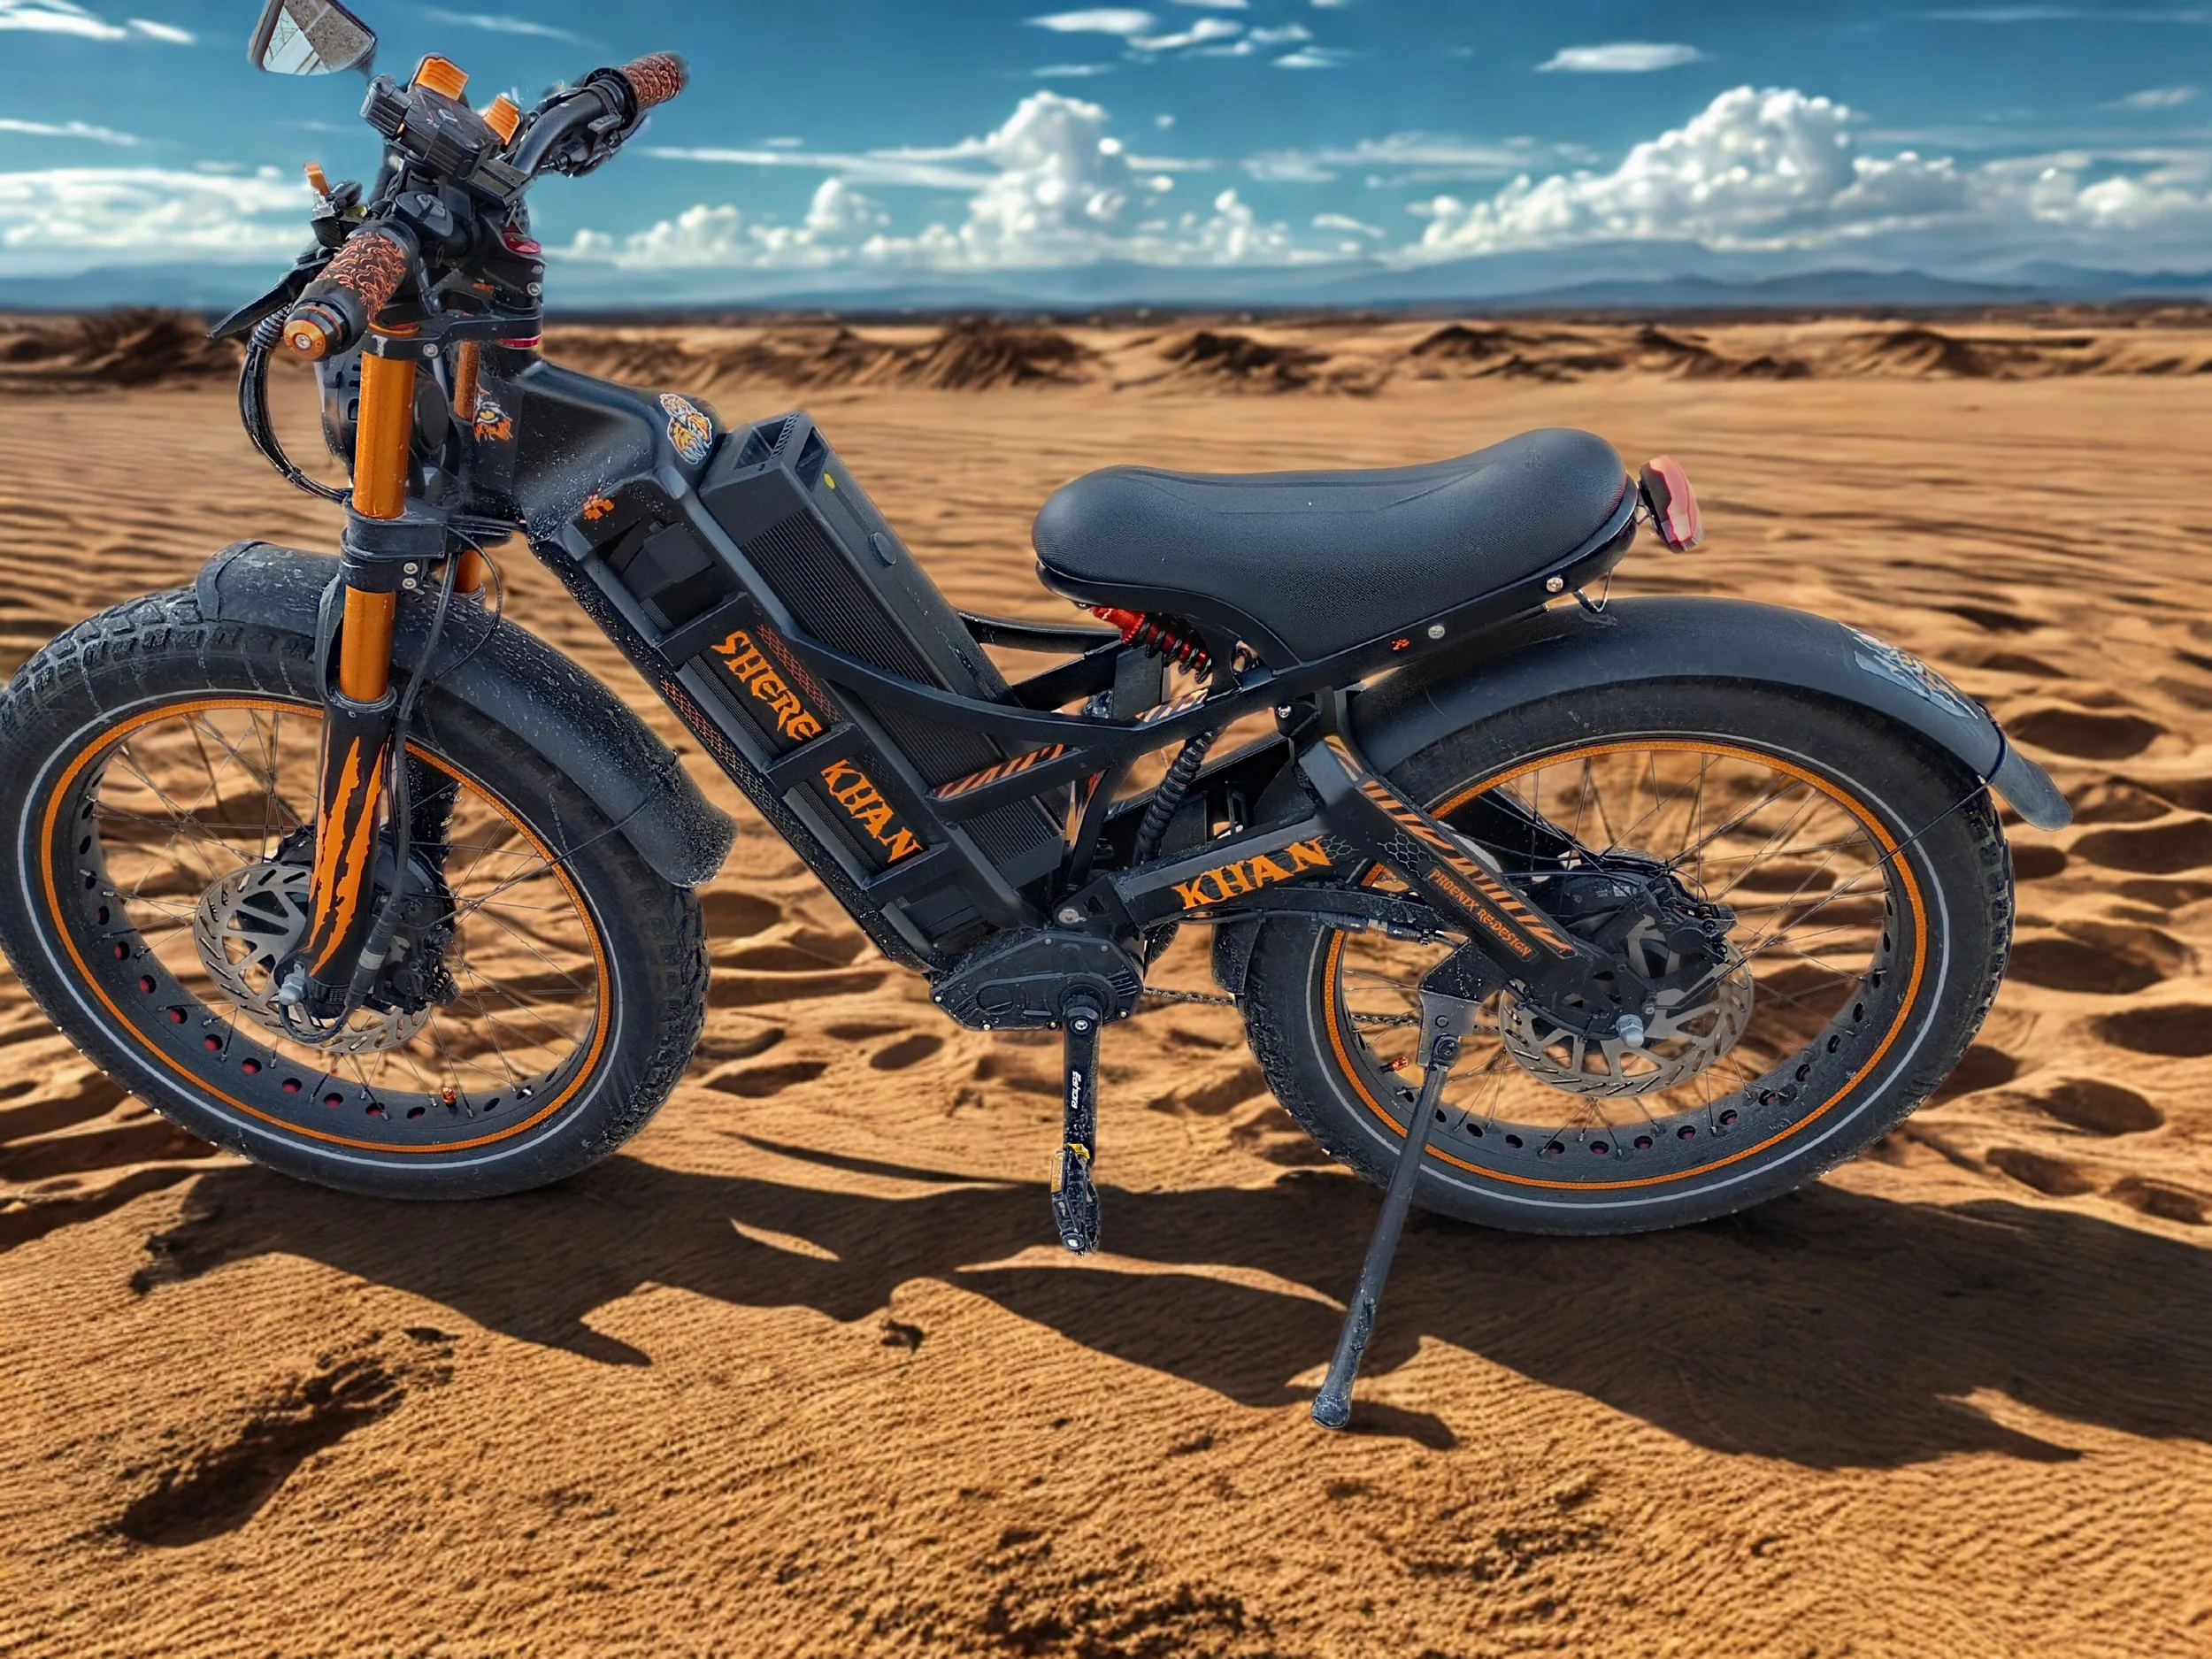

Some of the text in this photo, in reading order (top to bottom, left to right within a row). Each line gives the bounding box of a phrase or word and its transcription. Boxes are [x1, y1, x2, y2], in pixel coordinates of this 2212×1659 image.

[710, 630, 924, 863] SHERE KHAN
[1171, 835, 1333, 910] KHAN
[1428, 868, 1479, 912] PHOENIX
[1071, 1070, 1081, 1110] Eahora
